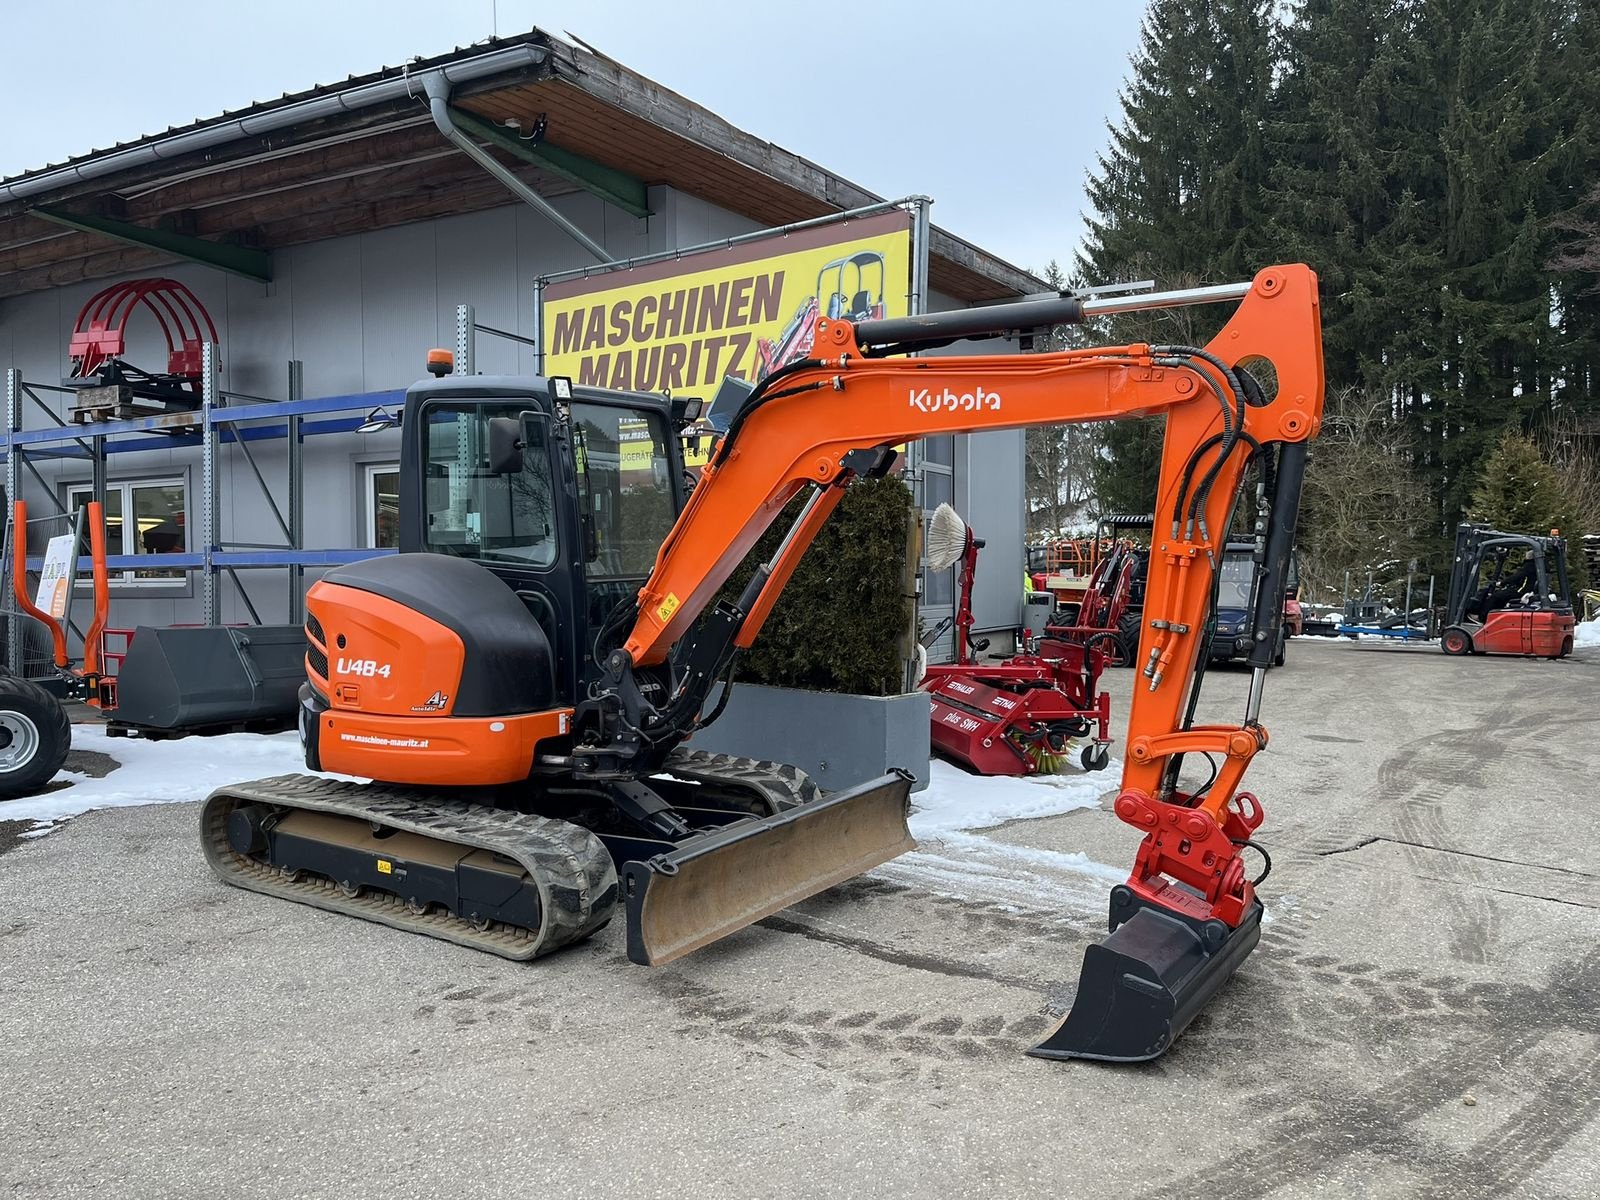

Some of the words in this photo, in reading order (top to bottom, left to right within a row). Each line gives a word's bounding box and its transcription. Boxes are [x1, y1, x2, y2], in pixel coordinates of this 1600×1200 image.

[552, 271, 784, 355] MASCHINEN
[579, 332, 752, 391] MAURITZ
[909, 386, 1001, 413] Kubota
[336, 657, 391, 678] U48-4
[952, 682, 975, 695] THALER
[942, 712, 962, 725] plus
[960, 718, 981, 733] SWH
[340, 733, 429, 748] www.maschinen-mauritz.at
